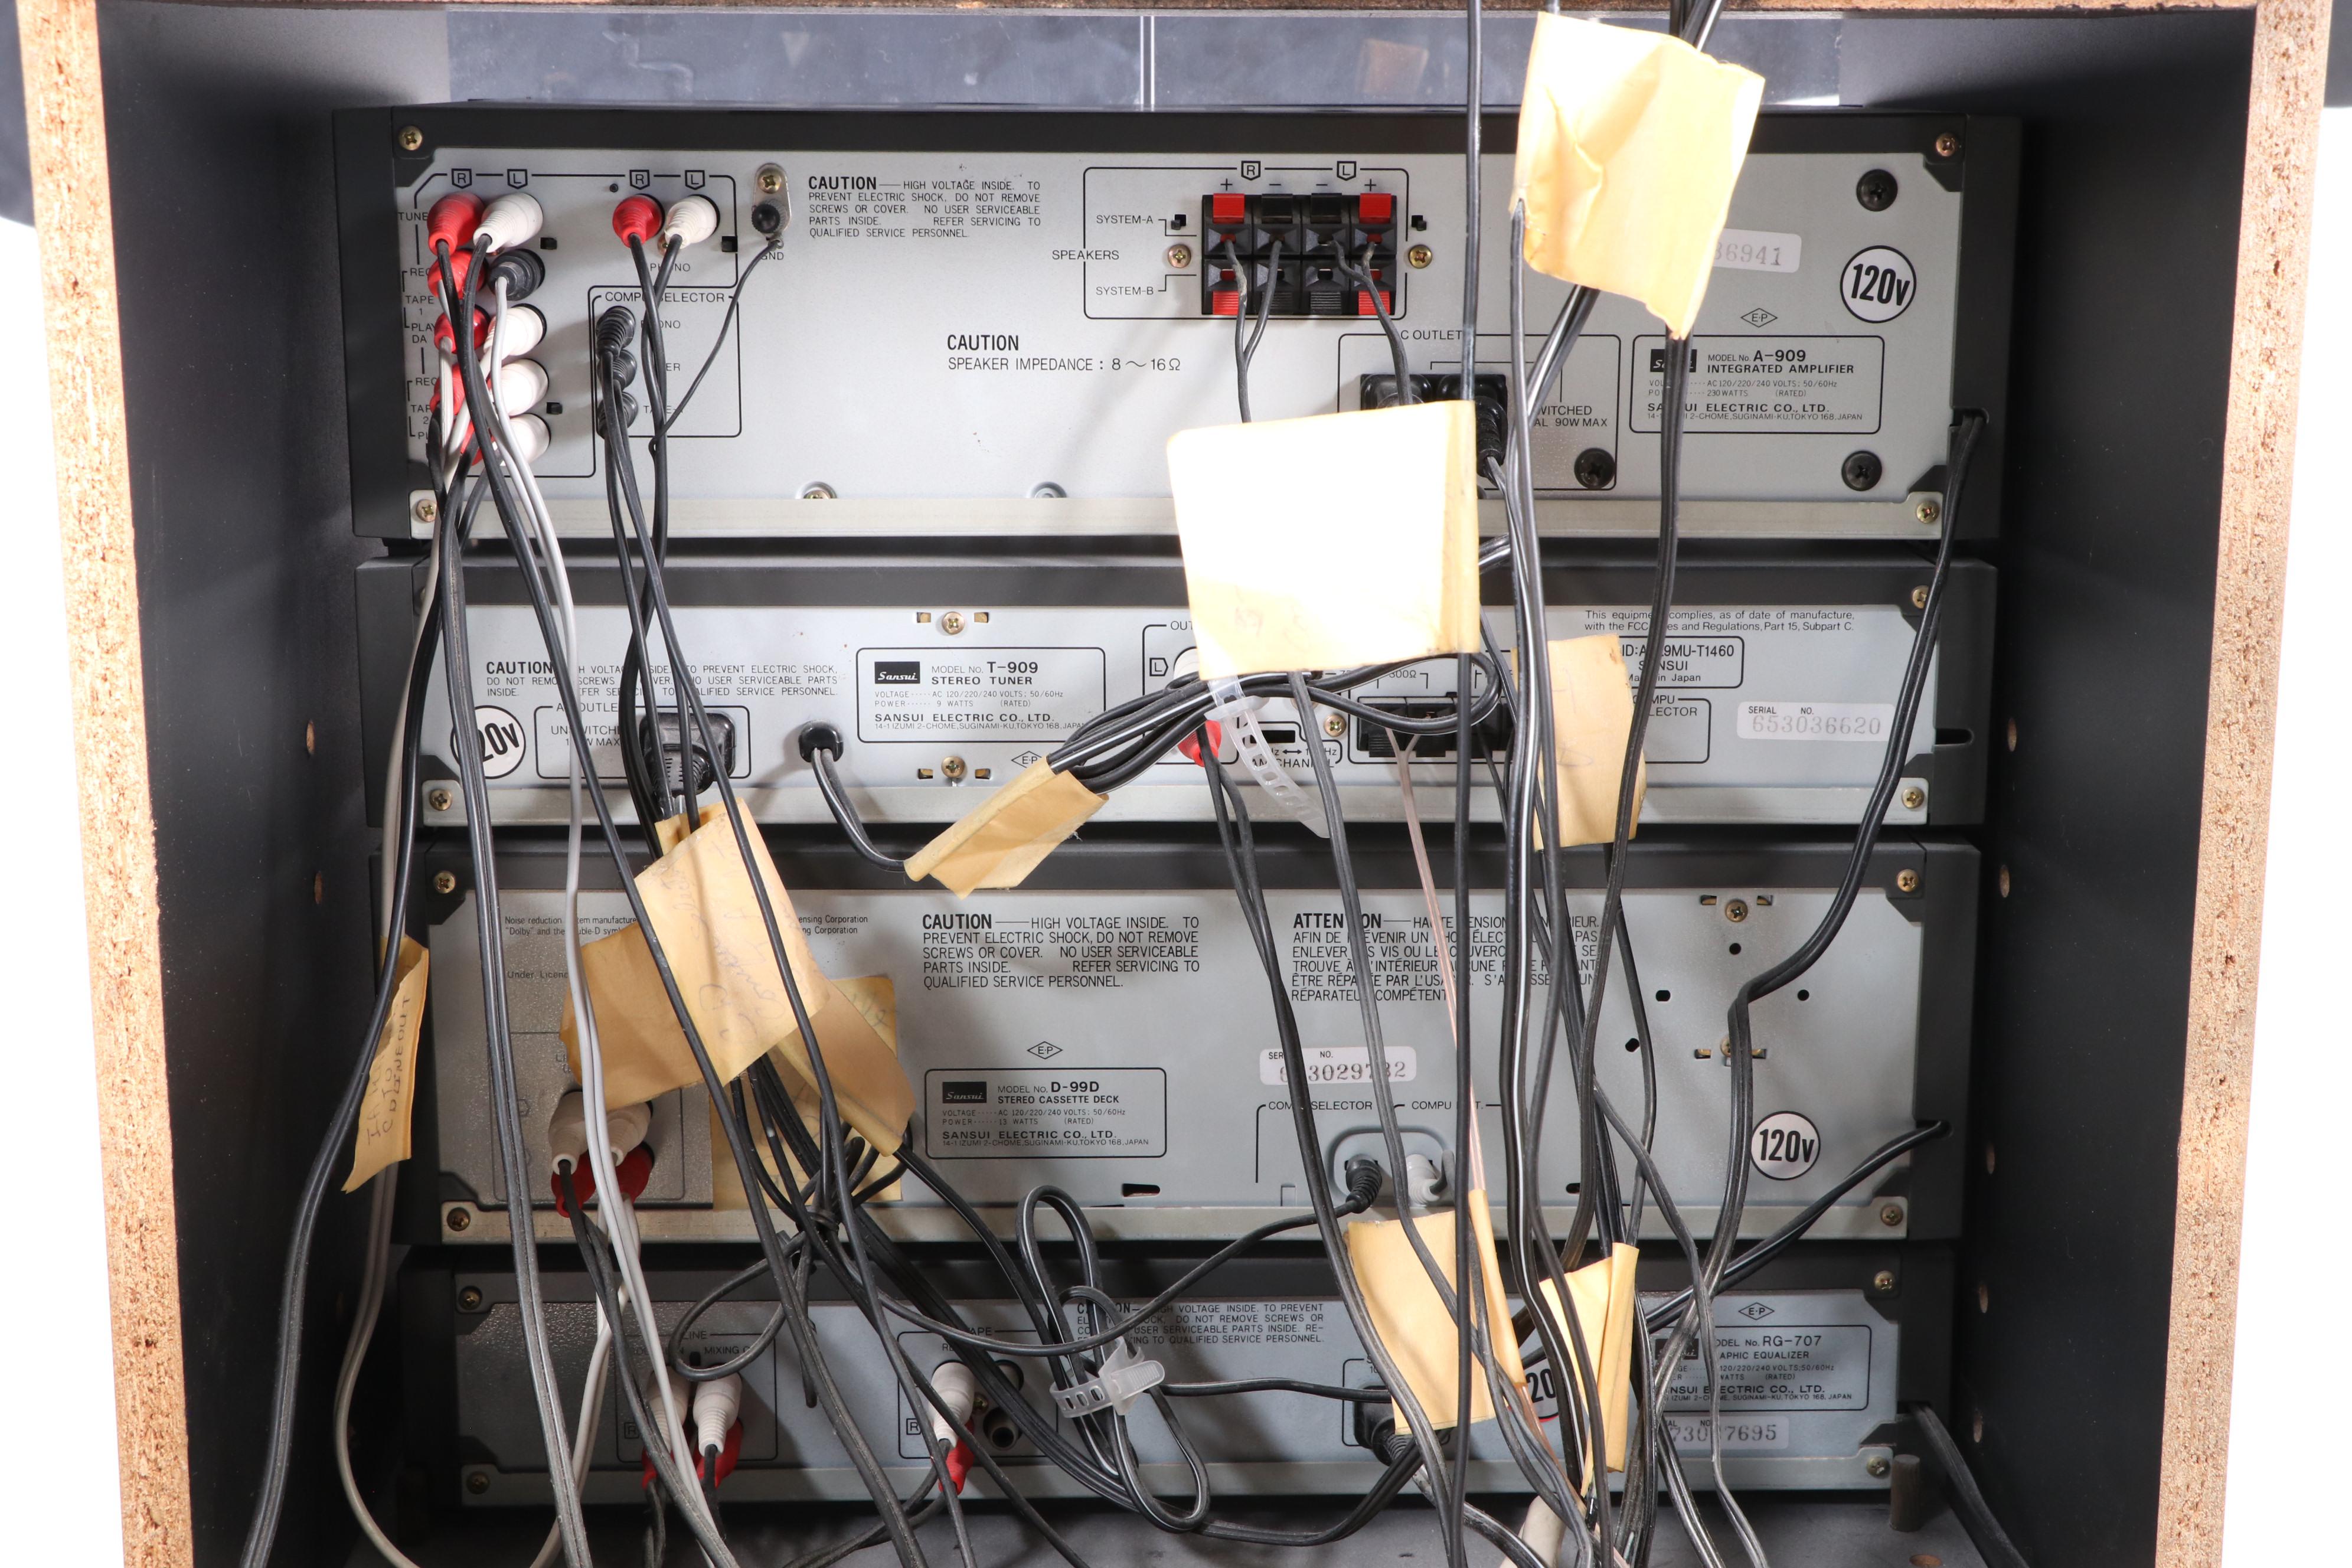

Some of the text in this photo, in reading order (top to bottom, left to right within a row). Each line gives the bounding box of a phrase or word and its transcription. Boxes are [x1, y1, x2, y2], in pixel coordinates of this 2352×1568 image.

[1247, 165, 1255, 175] R
[1342, 165, 1350, 175] L
[458, 173, 466, 184] R
[513, 174, 521, 184] L
[635, 174, 644, 184] R
[691, 175, 700, 185] L
[809, 177, 1040, 190] CAUTION HIGH VOLTAGE INSIDE. TO
[809, 192, 851, 202] PREVENT
[858, 192, 904, 201] ELECTRIC
[956, 193, 968, 201] DO
[975, 193, 994, 201] NOT
[1002, 194, 1040, 202] REMOVE
[810, 204, 848, 213] SCREWS
[855, 205, 867, 213] OR
[925, 205, 937, 213] NO
[945, 205, 969, 214] USER
[976, 205, 1039, 214] SERVICEABLE
[809, 217, 1020, 226] PARTS INSIDE. REFER SERVICING
[1097, 215, 1153, 224] SYSTEM-A
[1053, 250, 1119, 260] SPEAKERS
[1096, 286, 1154, 295] SYSTEM-B
[406, 296, 434, 305] TAPE
[948, 335, 1018, 351] CAUTION
[1753, 349, 1805, 361] A-909
[949, 357, 1092, 371] SPEAKER IMPEDANCE
[1789, 365, 1853, 373] AMPLIFIER
[1707, 404, 1768, 412] ELECTRIC
[1556, 418, 1579, 426] 90W
[1585, 610, 1854, 620] This complies, as of date of manufacture,
[1585, 620, 1853, 632] with the FCC and Regulations, Part 15, Subpart C.
[486, 662, 553, 675] CAUTION
[878, 672, 917, 680] Sansui
[987, 662, 1038, 673] T-909
[739, 676, 801, 684] SERVICEABLE
[932, 677, 980, 685] STEREO
[1672, 674, 1700, 682] Japan
[876, 714, 923, 723] SANSUI
[933, 714, 994, 723] ELECTRIC
[1028, 714, 1054, 723] LTD.
[1753, 715, 1880, 734] 653036620
[528, 916, 561, 925] reduction
[825, 914, 867, 925] Corporation
[923, 914, 1198, 929] CAUTION HIGH VOLTAGE INSIDE. TO
[815, 926, 857, 935] Corporation
[924, 932, 980, 943] PREVENT
[985, 932, 1043, 943] ELECTRIC
[1097, 932, 1113, 943] DO
[1119, 932, 1143, 943] NOT
[1149, 931, 1198, 944] REMOVE
[1293, 932, 1322, 943] AFIN
[923, 947, 973, 959] SCREWS
[979, 947, 995, 958] OR
[1060, 946, 1076, 958] NO
[1082, 946, 1112, 958] USER
[1118, 946, 1198, 958] SERVICEABLE
[1293, 946, 1399, 958] ENLEVER VIS
[923, 961, 1199, 973] PARTS INSIDE. REFER SERVICING TO
[1293, 961, 1340, 972] TROUVE
[924, 975, 1123, 989] QUALIFIED SERVICE PERSONNEL.
[1387, 975, 1409, 986] PAR
[1051, 1082, 1099, 1092] D-99D
[998, 1096, 1034, 1104] STEREO
[1311, 1101, 1451, 1110] SELECTOR COMPU
[943, 1131, 989, 1139] SANSUI
[999, 1131, 1058, 1139] ELECTRIC
[1090, 1131, 1116, 1139] LTD.
[1179, 1304, 1323, 1314] VOLTAGE INSIDE. PREVENT
[1265, 1314, 1304, 1322] SCREWS
[1164, 1325, 1227, 1333] SERVICEABLE
[1763, 1335, 1822, 1347] RG-707
[1754, 1351, 1809, 1359] EQUALIZER
